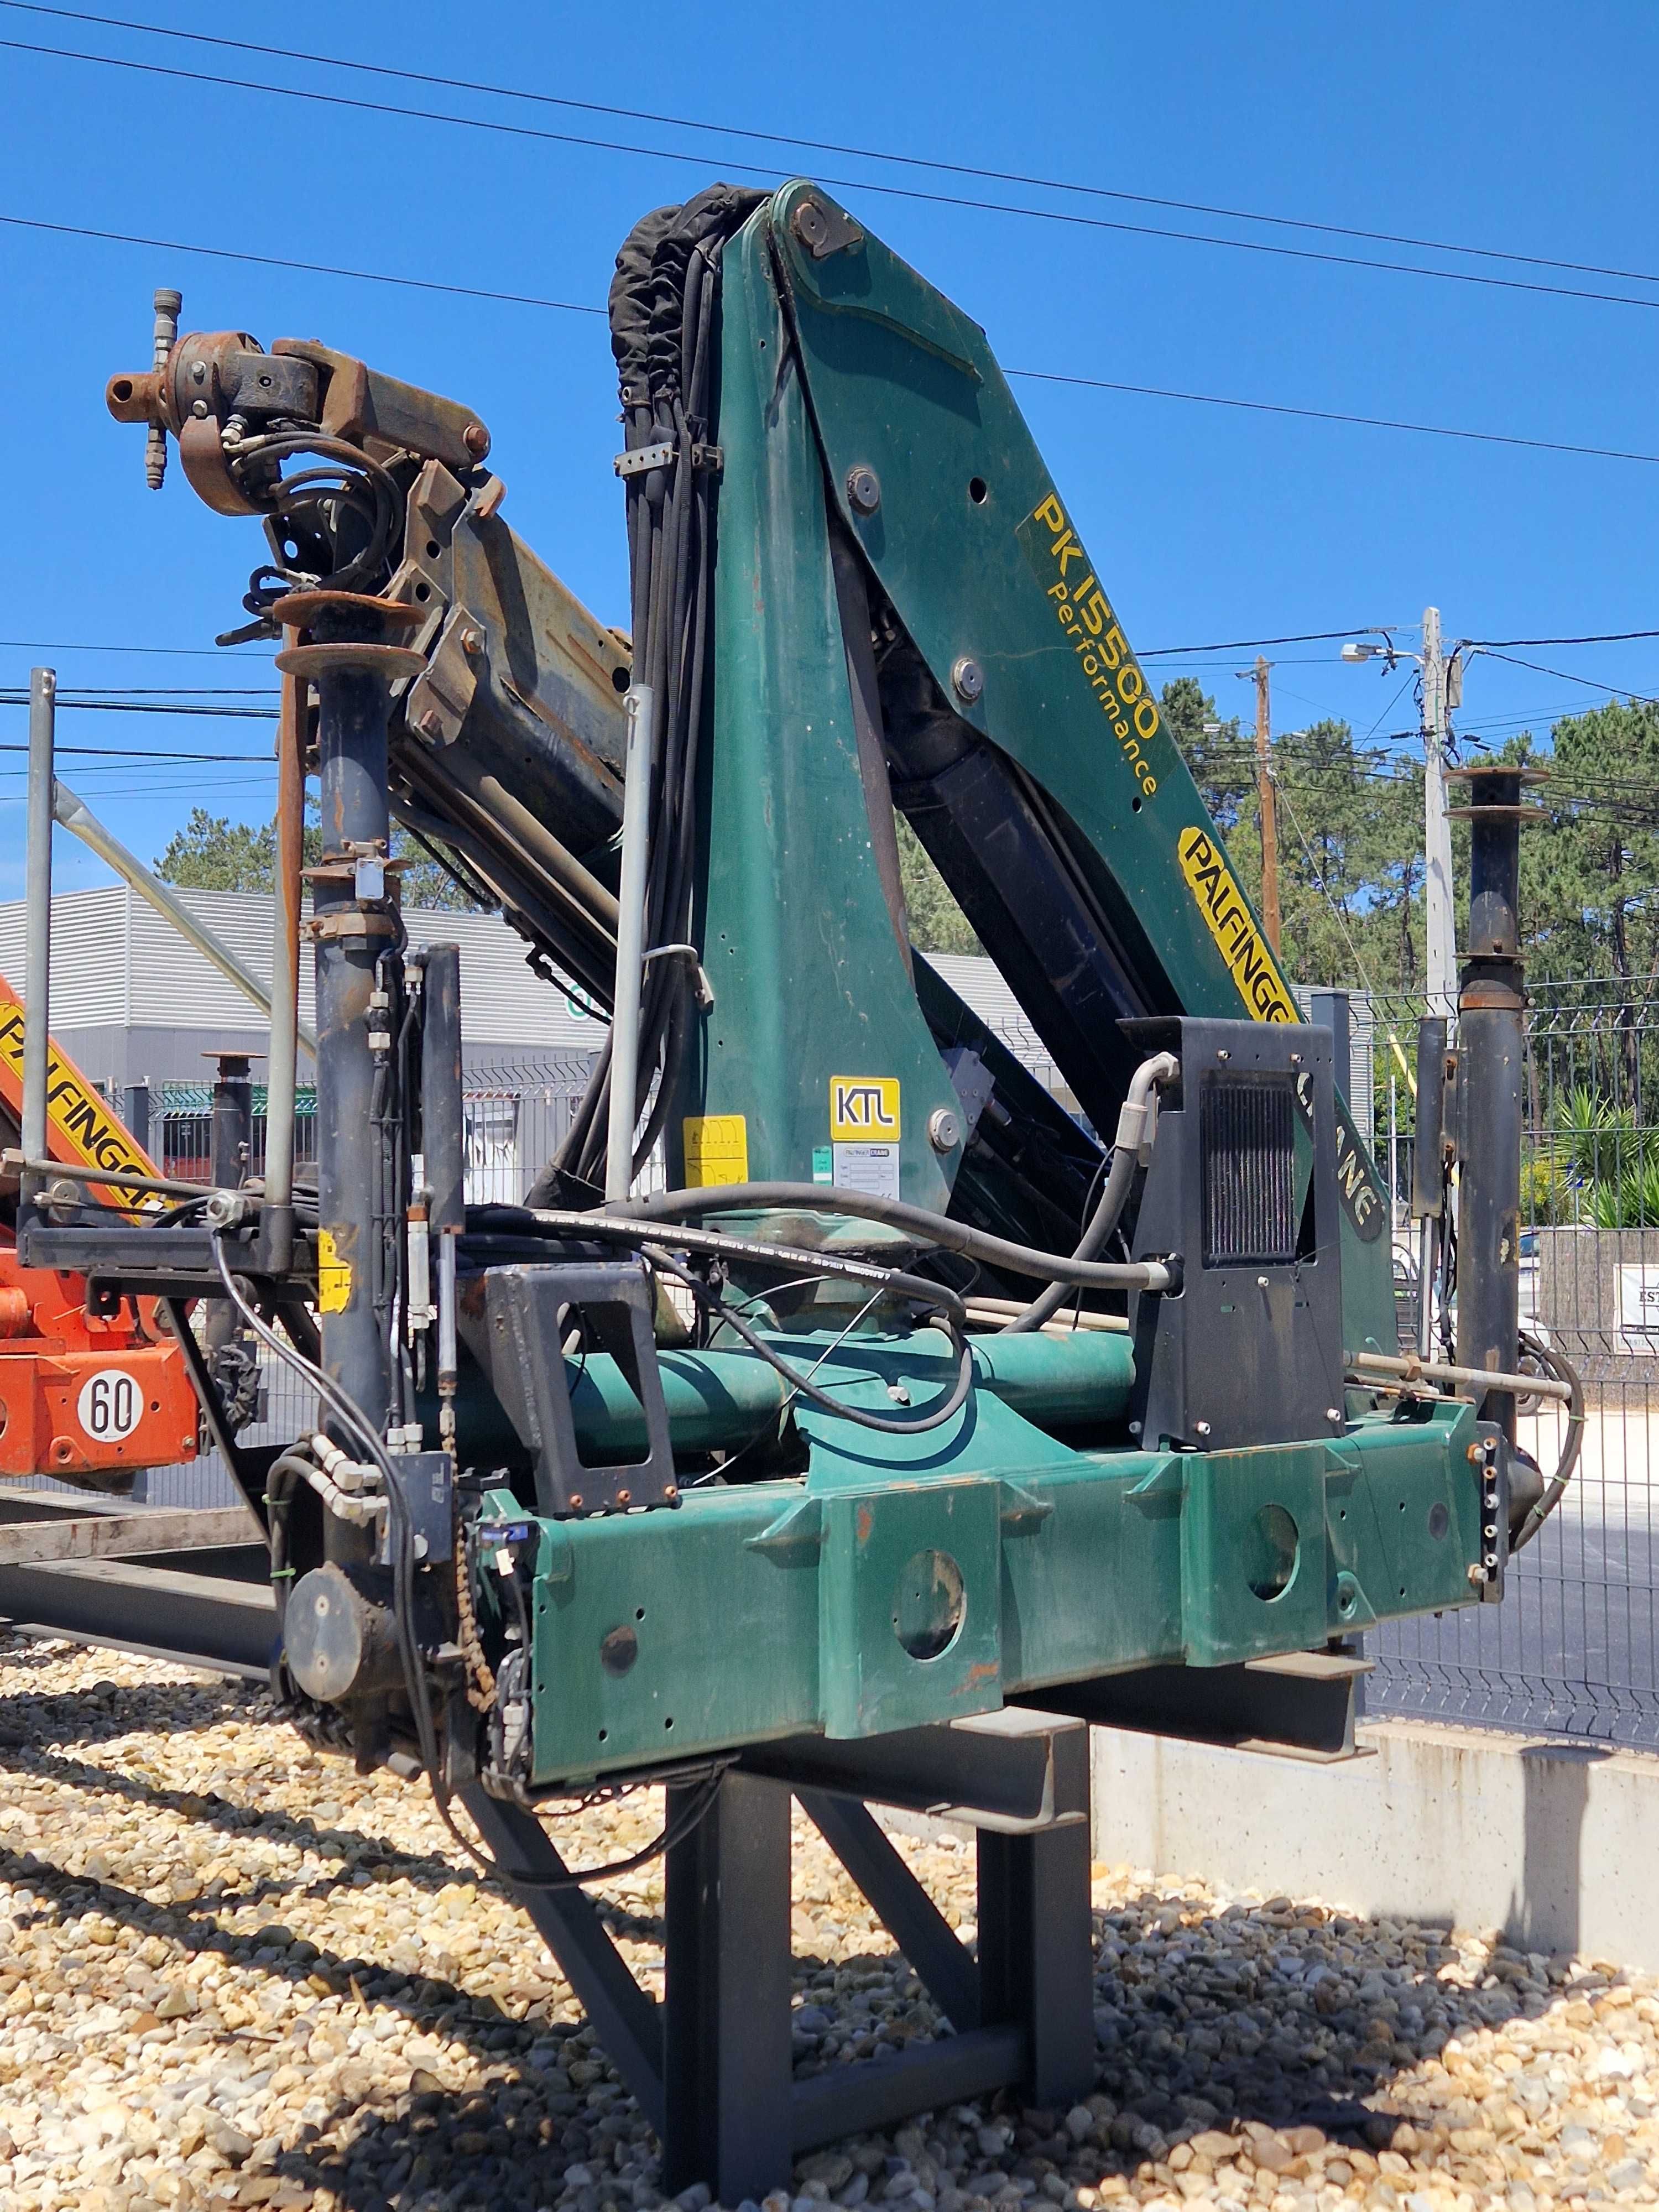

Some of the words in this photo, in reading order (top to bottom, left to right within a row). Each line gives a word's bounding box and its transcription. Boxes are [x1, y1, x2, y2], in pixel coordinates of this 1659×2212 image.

[1185, 831, 1293, 1022] PALFINGE
[838, 1088, 893, 1124] KTL
[91, 1378, 132, 1433] 60
